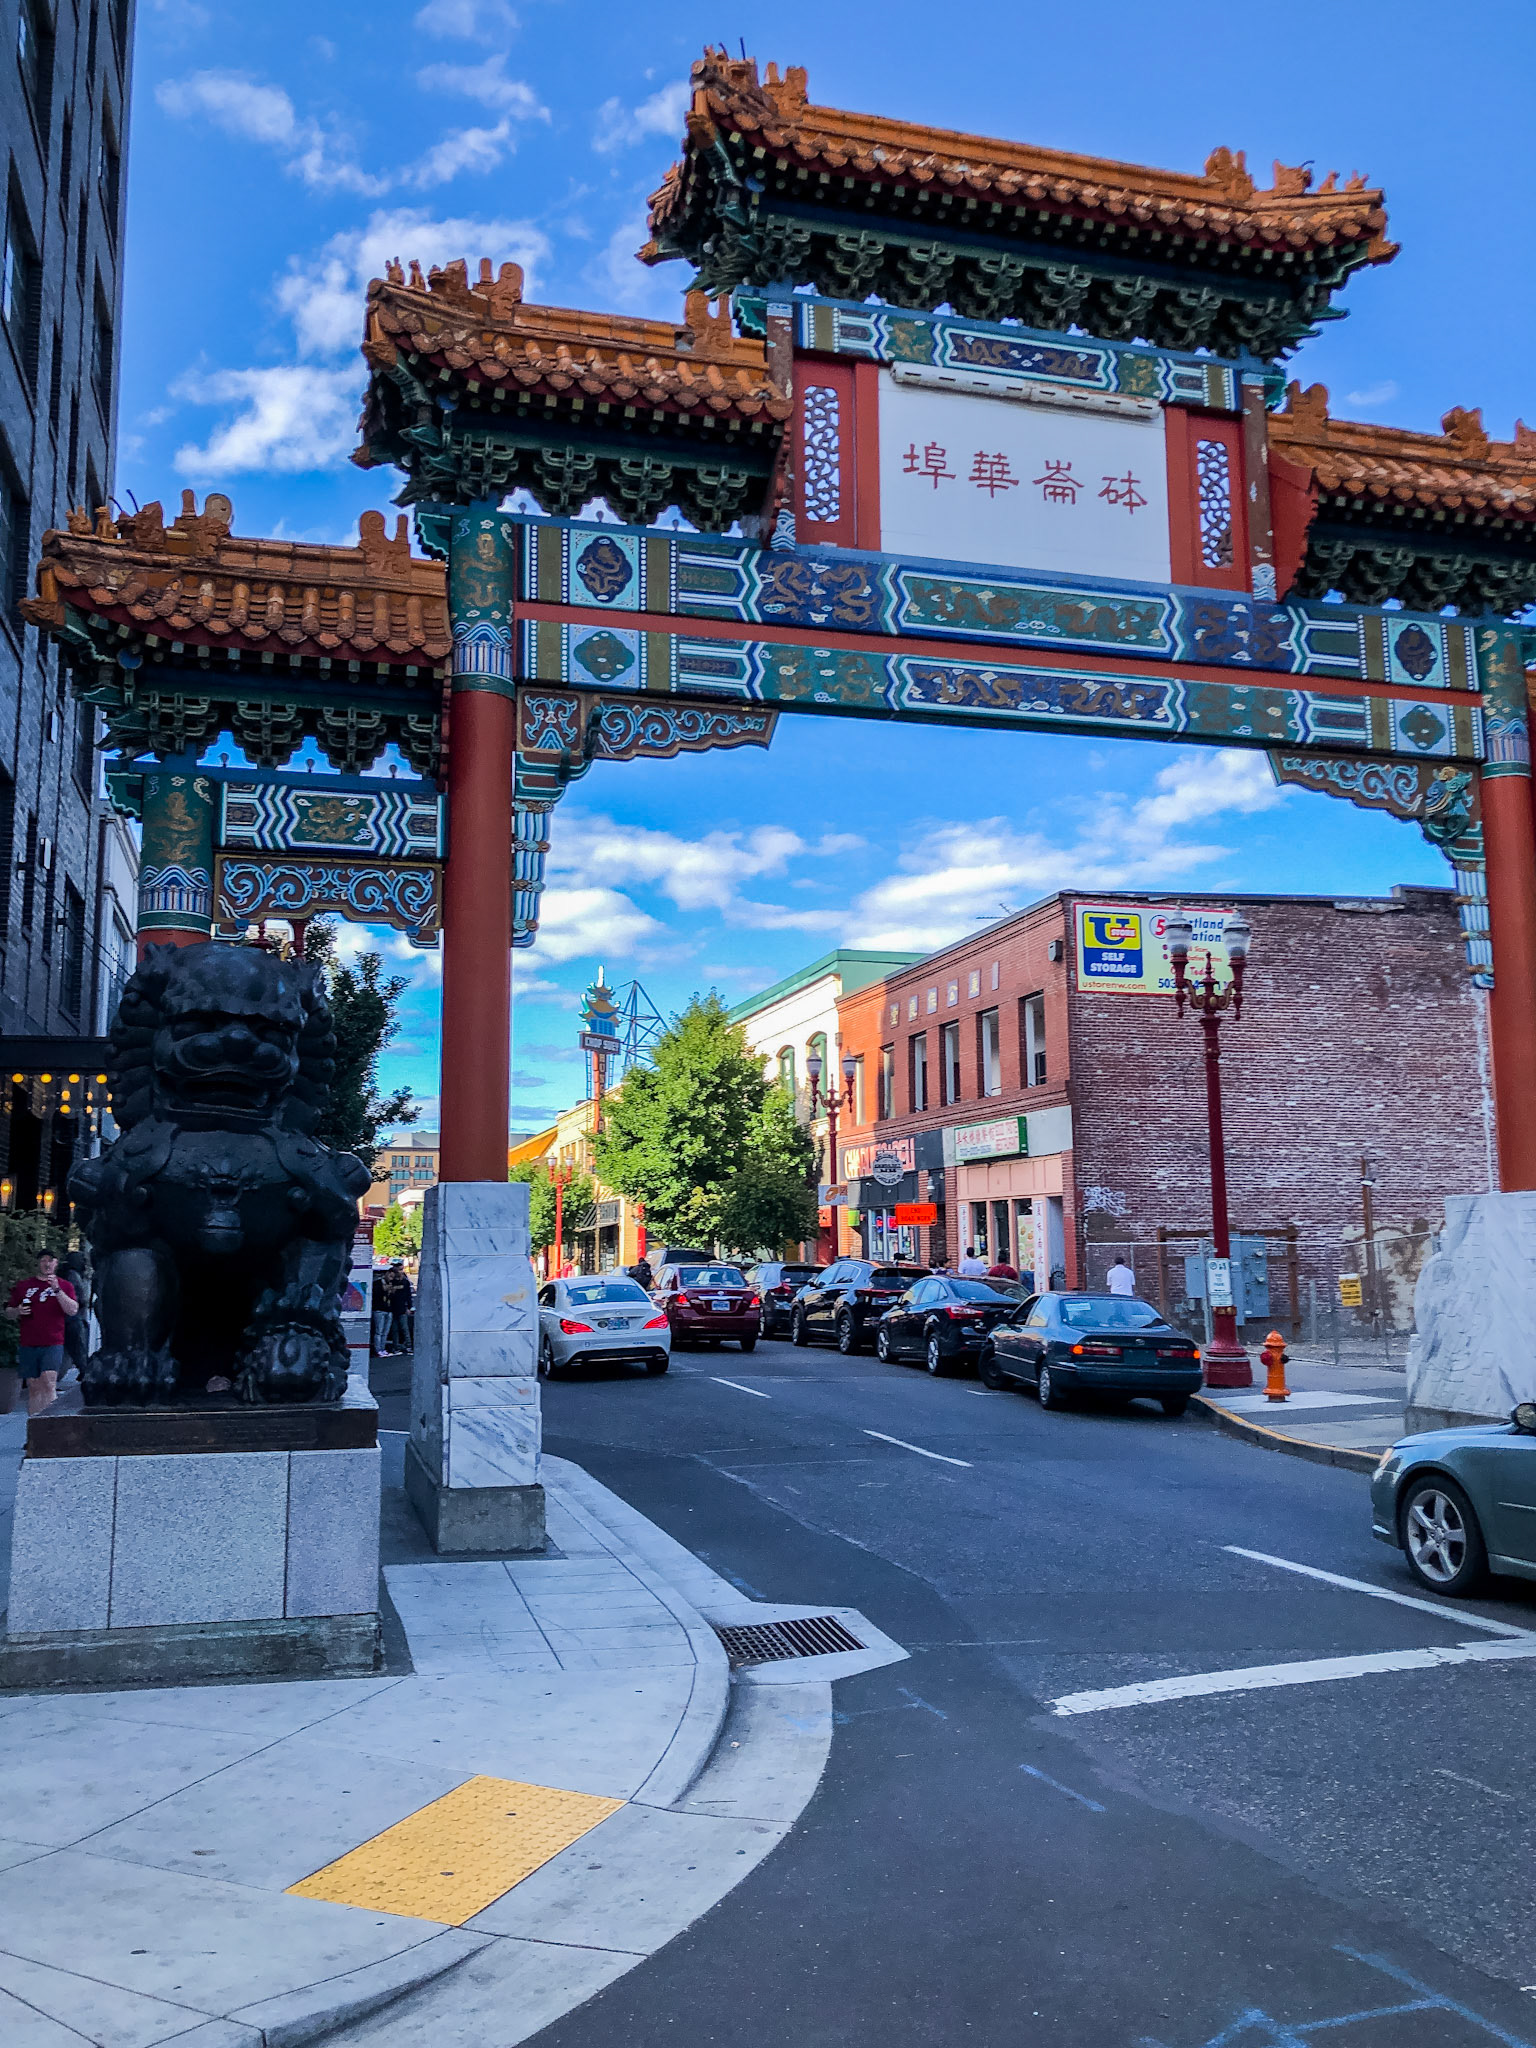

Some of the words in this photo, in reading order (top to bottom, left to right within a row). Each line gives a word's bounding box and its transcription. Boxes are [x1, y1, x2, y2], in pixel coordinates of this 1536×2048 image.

[1088, 916, 1130, 946] U
[1101, 951, 1125, 962] SELF
[1090, 962, 1137, 974] STORAGE
